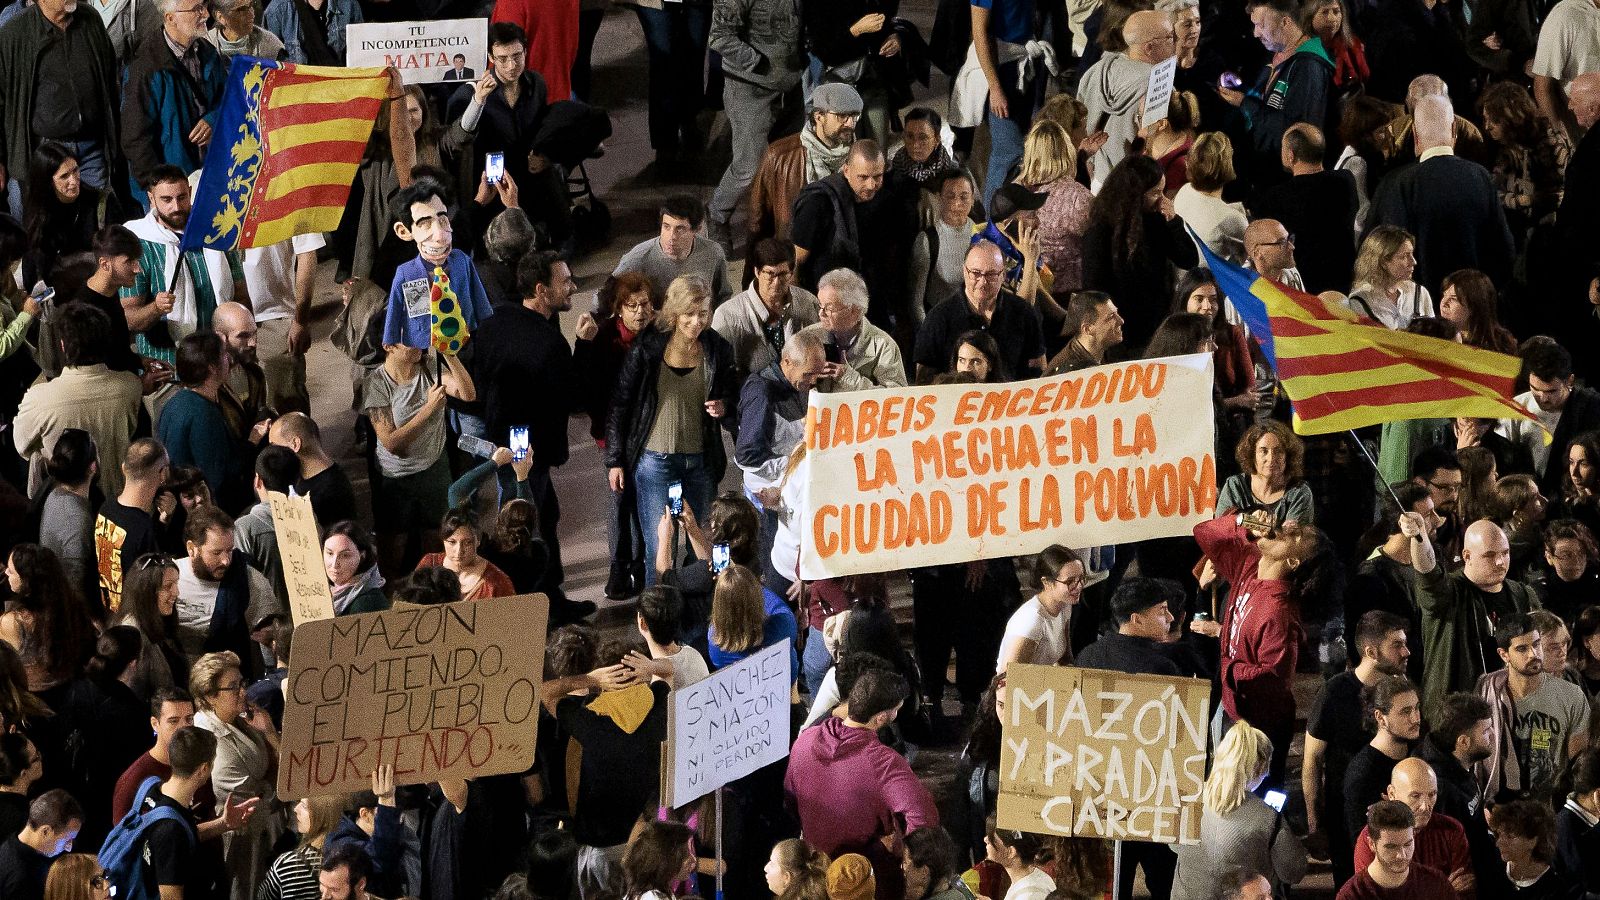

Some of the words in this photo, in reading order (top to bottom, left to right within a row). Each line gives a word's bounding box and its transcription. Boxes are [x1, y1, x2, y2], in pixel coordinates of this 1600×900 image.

[361, 36, 470, 51] INCOMPETENCIA
[384, 51, 450, 69] MATA
[408, 26, 426, 36] TU
[806, 394, 938, 450] HABEIS
[953, 363, 1168, 425] ENCENDIDO
[853, 448, 898, 492] LA
[911, 424, 1042, 485] MECHA
[1044, 414, 1100, 467] EN
[1112, 413, 1157, 457] LA
[813, 490, 953, 560] CIUDAD
[966, 481, 1009, 539] DE
[1019, 474, 1063, 532] LA
[1074, 453, 1217, 525] POLVORA
[311, 702, 363, 746] EL
[381, 678, 535, 737] PUEBLO
[688, 732, 699, 748] Y
[1011, 685, 1209, 751] MAZÓN
[688, 753, 704, 770] NI
[713, 719, 770, 755] OLVIDO
[1007, 737, 1029, 781] Y
[1044, 741, 1207, 808] PRADAS
[688, 772, 704, 788] NI
